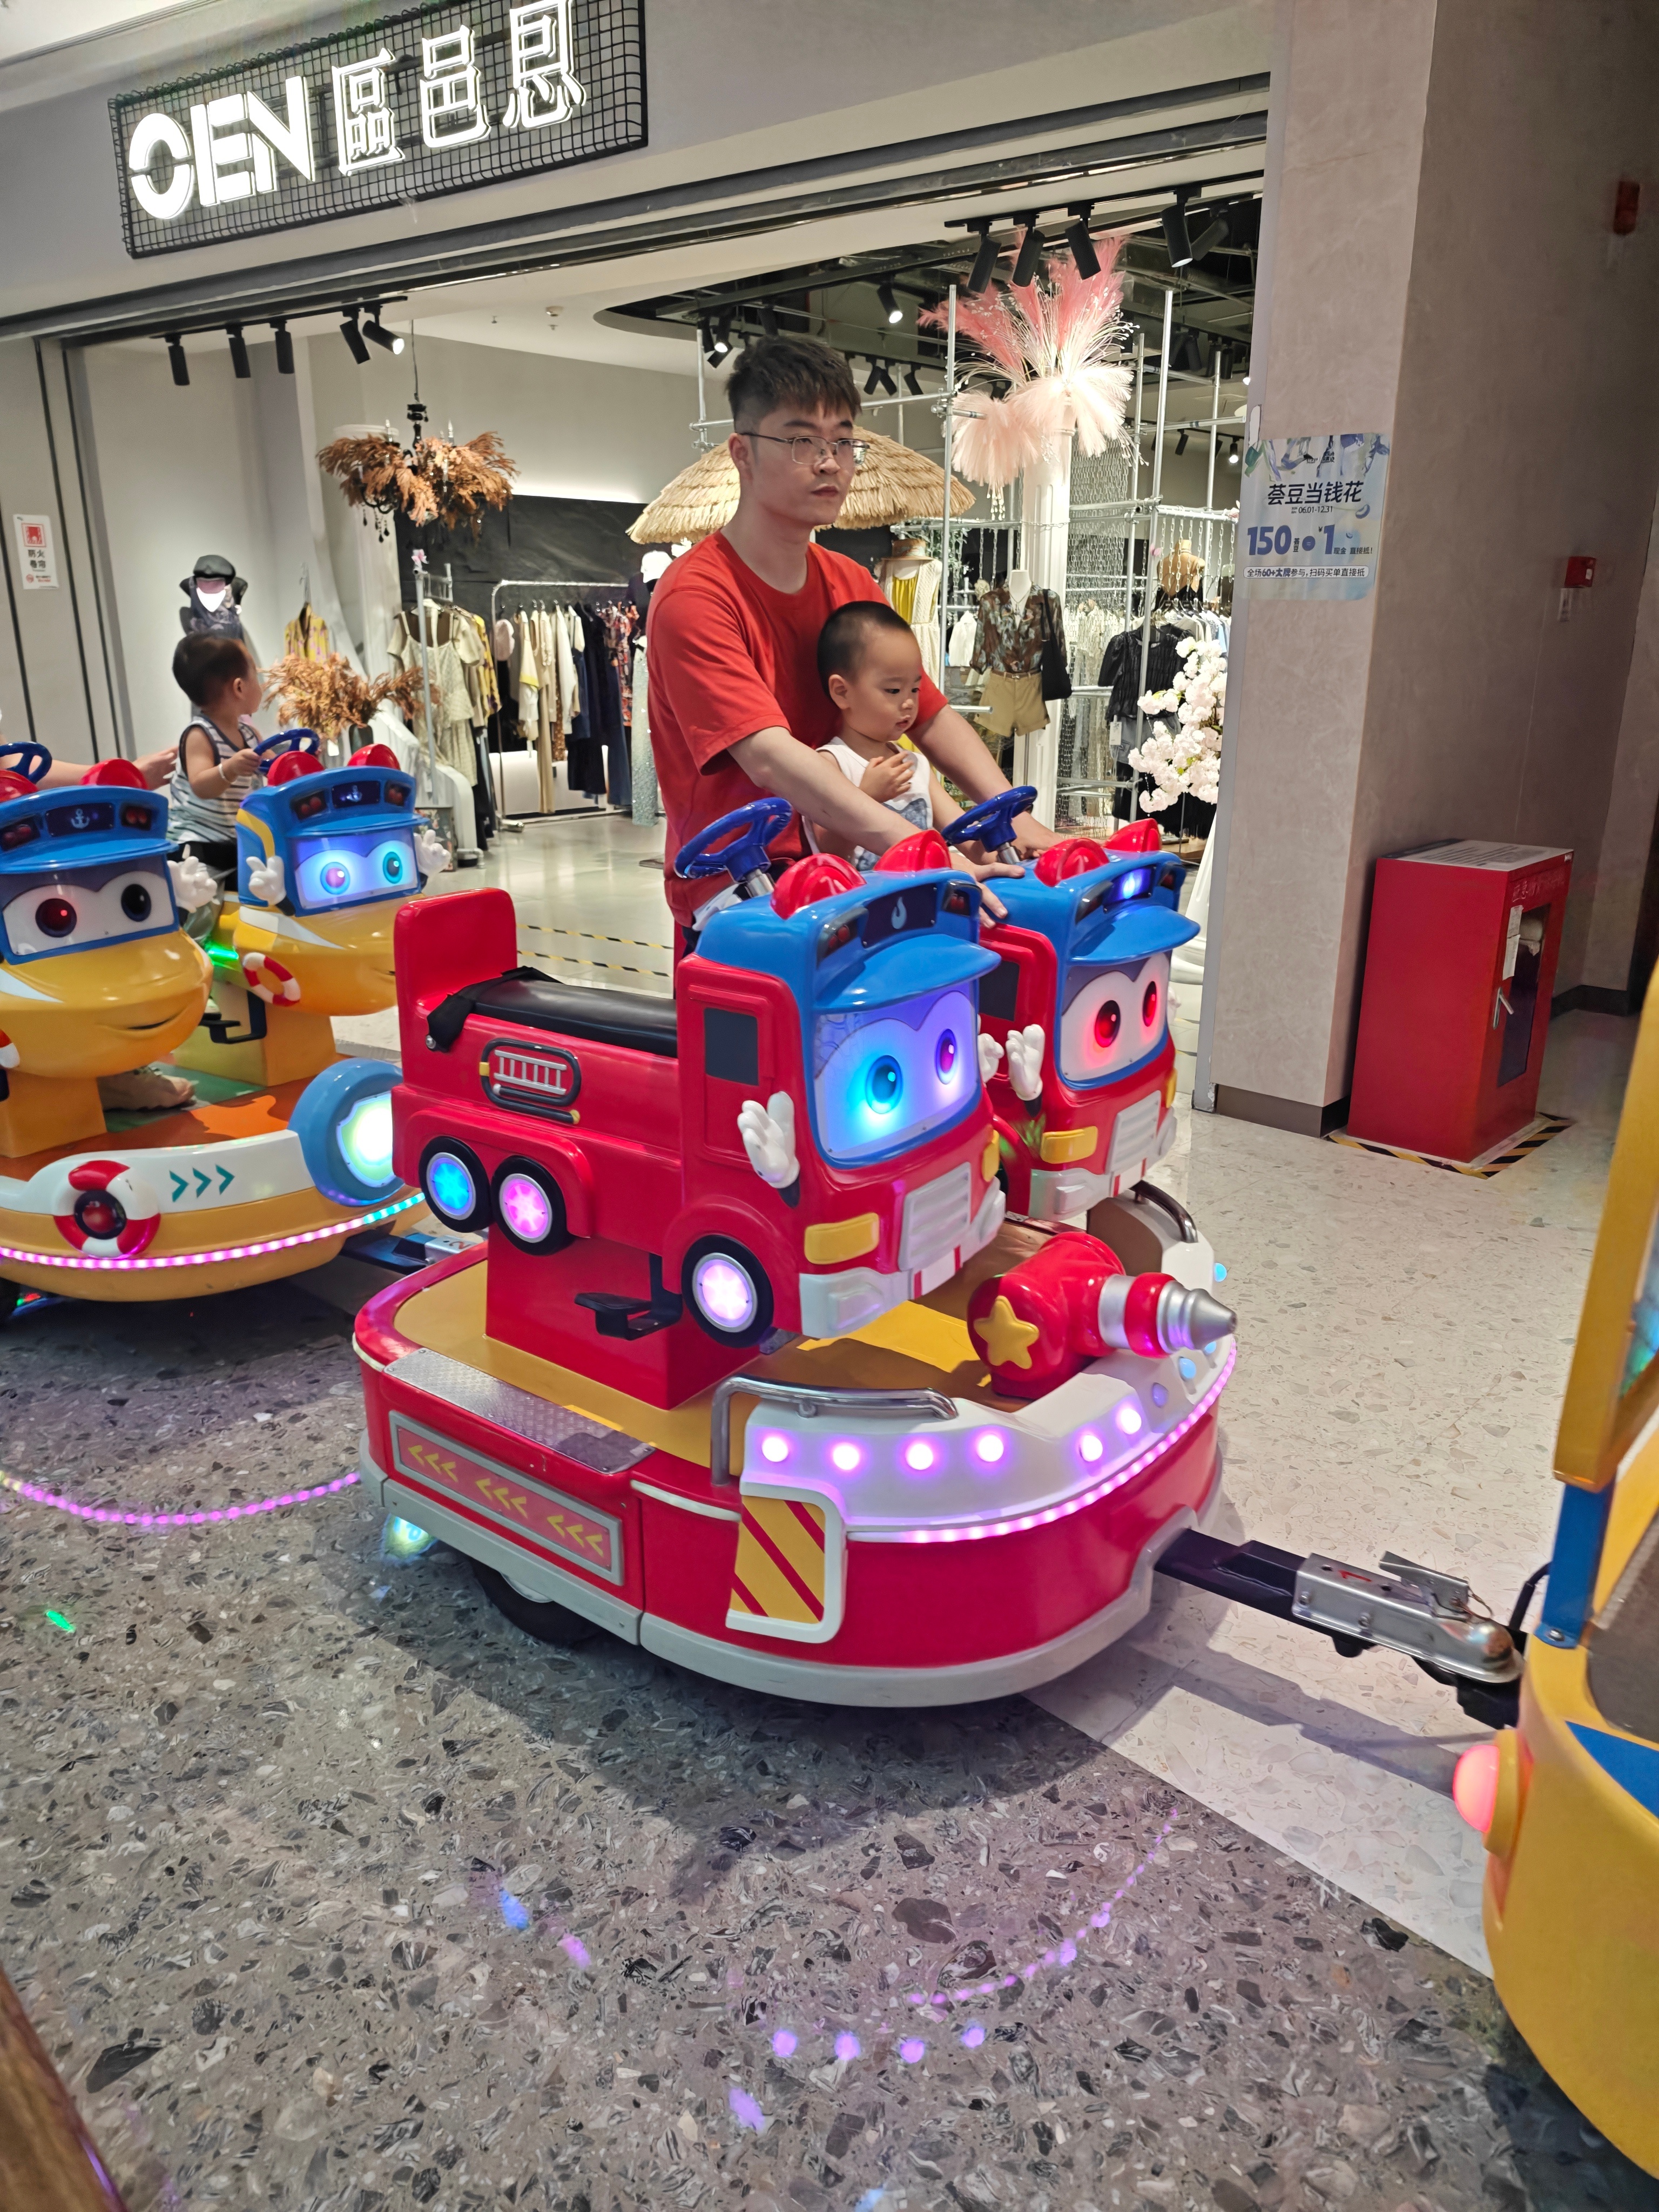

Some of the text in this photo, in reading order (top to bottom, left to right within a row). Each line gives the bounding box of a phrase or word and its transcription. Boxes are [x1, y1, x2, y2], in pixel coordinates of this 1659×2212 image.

[1267, 480, 1364, 505] 荟豆当钱花
[1247, 524, 1292, 556] 150
